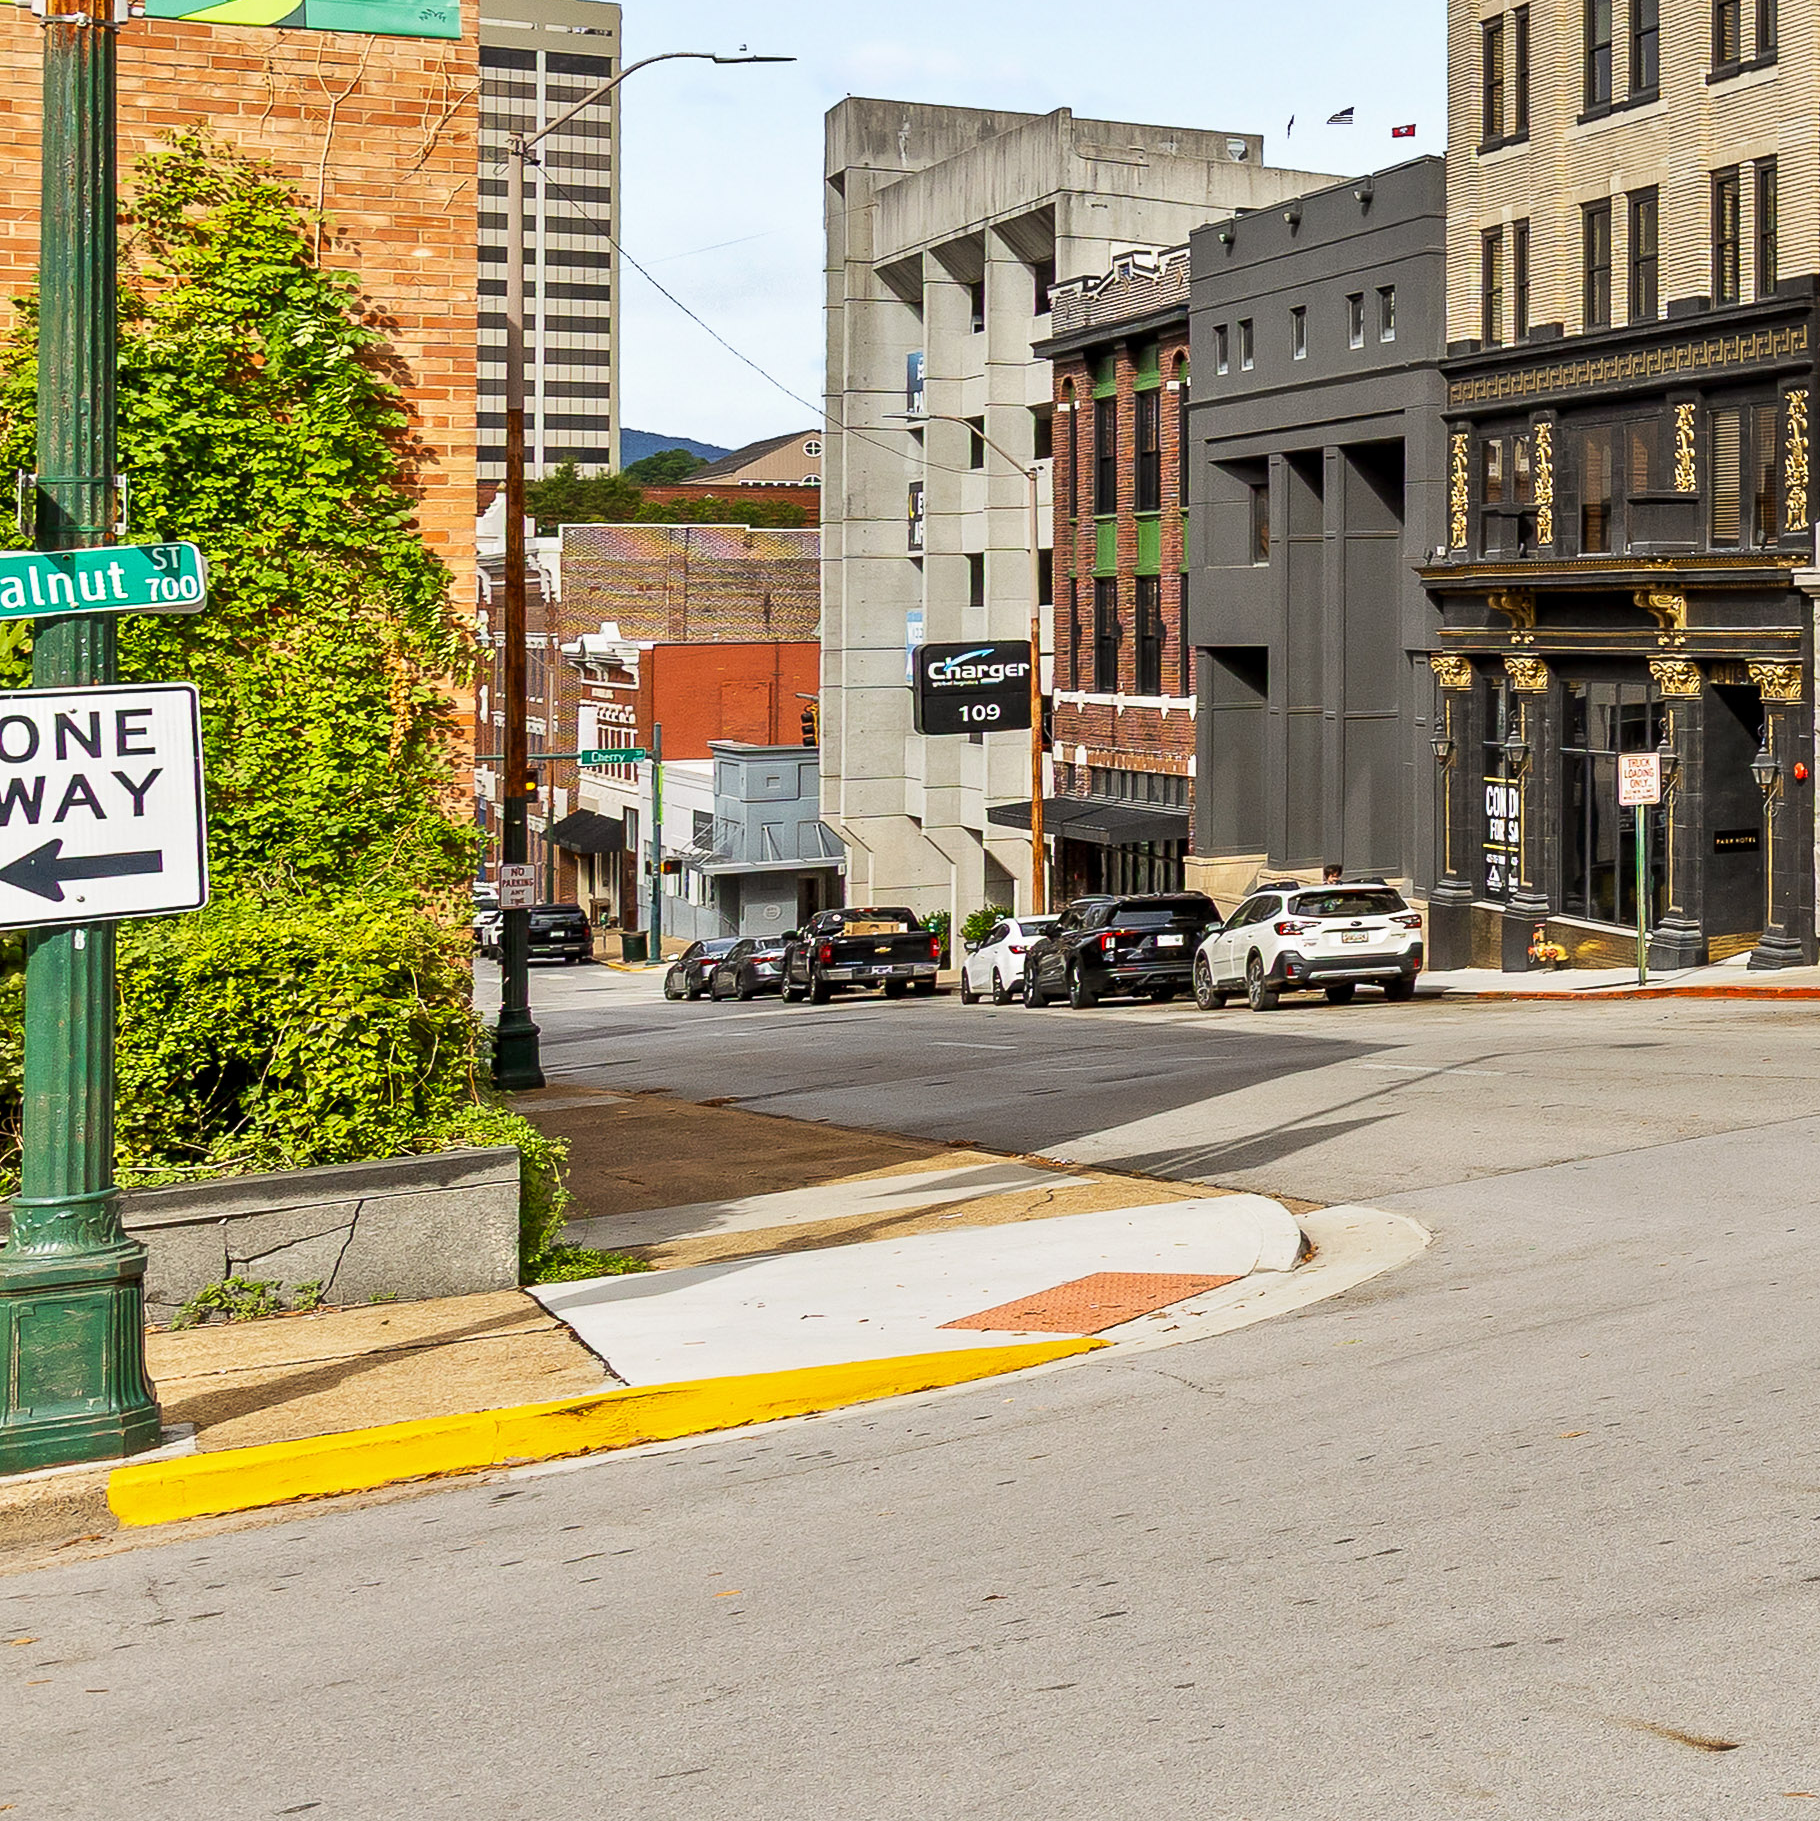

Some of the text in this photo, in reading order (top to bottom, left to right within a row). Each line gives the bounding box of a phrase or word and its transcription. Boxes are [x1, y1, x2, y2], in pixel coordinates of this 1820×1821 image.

[152, 546, 180, 570] ST
[0, 561, 129, 609] alnut
[145, 575, 198, 601] 700
[928, 656, 1030, 682] Charger
[958, 703, 1001, 722] 109
[0, 708, 157, 764] ONE
[591, 751, 626, 763] Cherry
[1628, 757, 1650, 768] TRUCK
[1624, 768, 1655, 778] LOADING
[1630, 778, 1649, 789] ONLY
[0, 768, 164, 827] WAY
[1490, 819, 1519, 842] FOR SA
[511, 867, 525, 876] NO
[502, 878, 534, 888] PARKING
